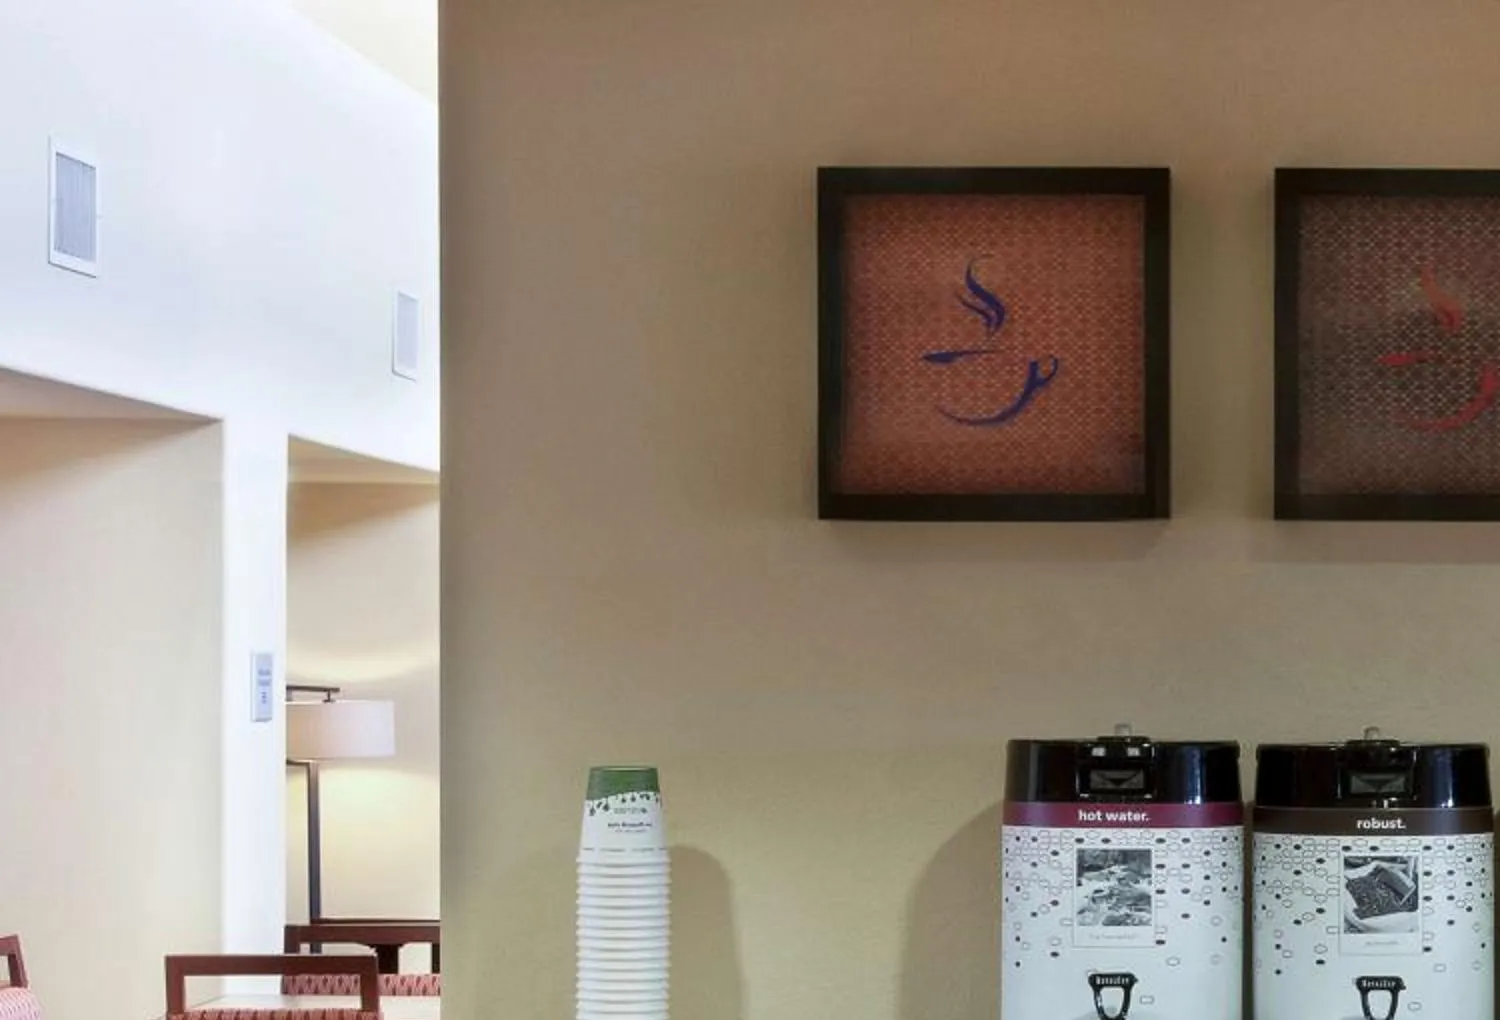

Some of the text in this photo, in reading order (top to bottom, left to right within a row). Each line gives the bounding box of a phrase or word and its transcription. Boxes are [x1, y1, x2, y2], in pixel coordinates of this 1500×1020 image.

[1078, 809, 1150, 822] hot water.
[1356, 817, 1407, 829] robust.
